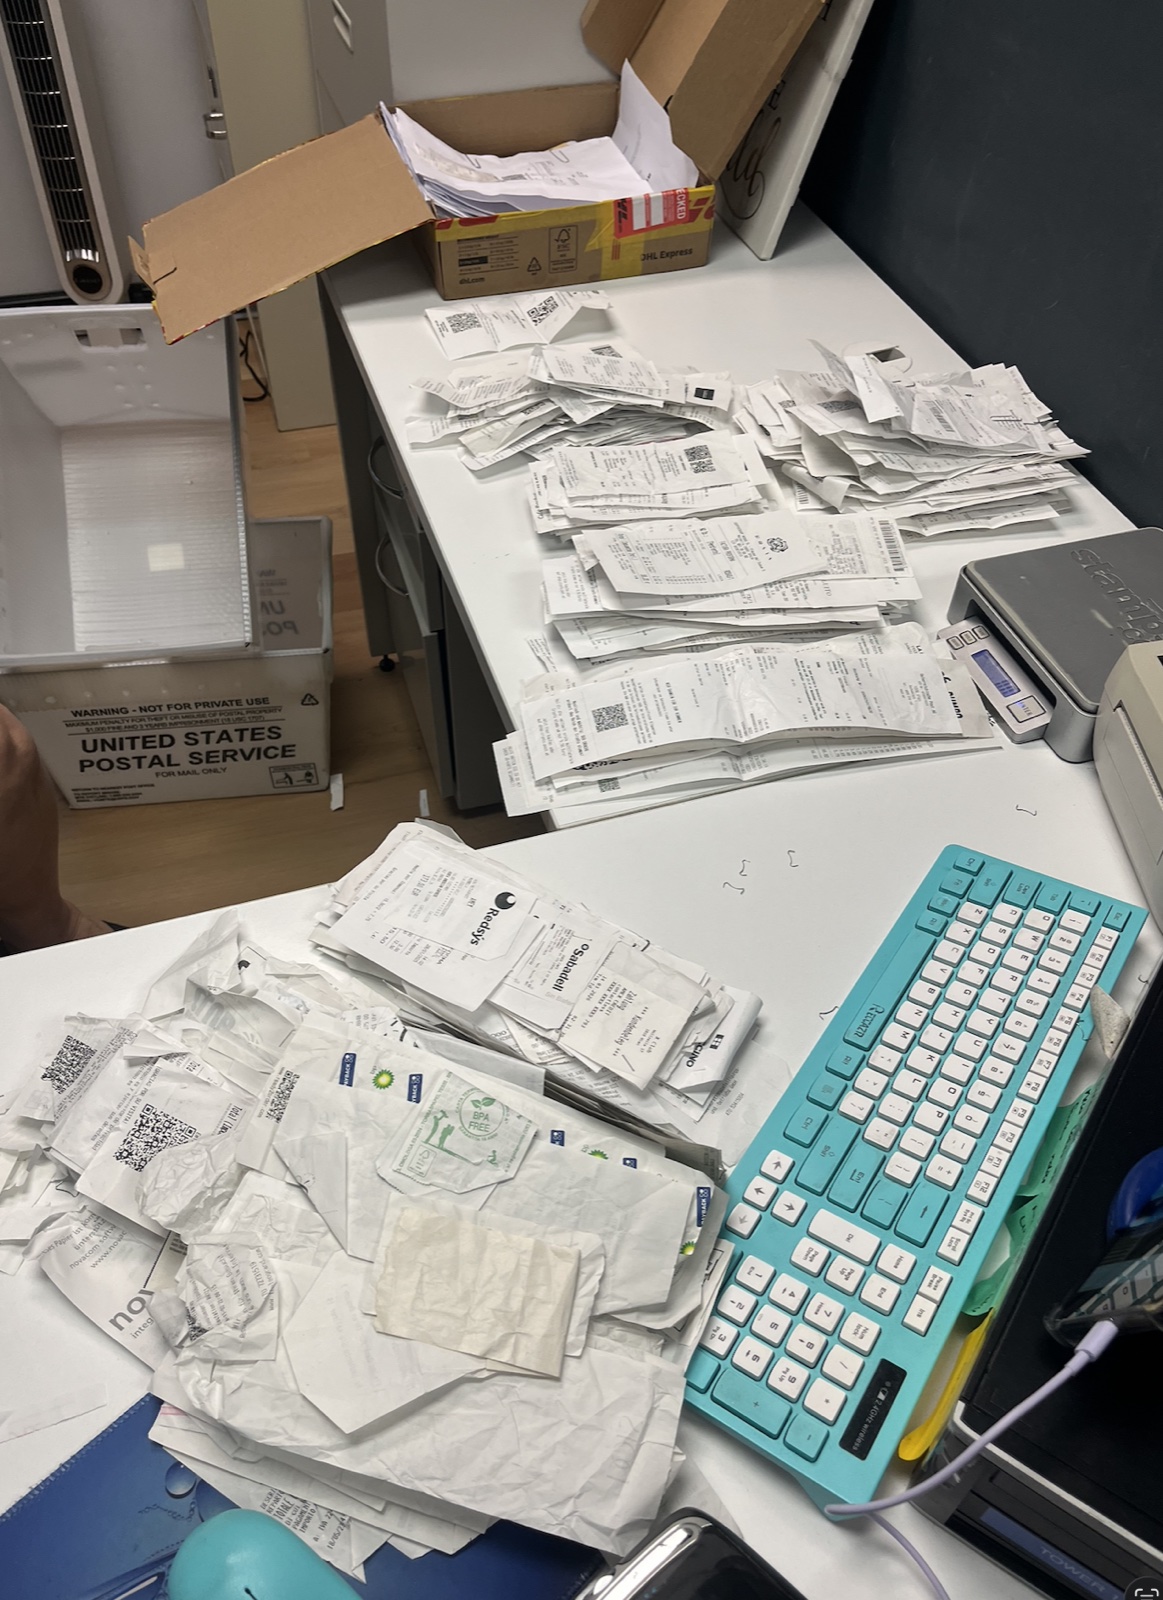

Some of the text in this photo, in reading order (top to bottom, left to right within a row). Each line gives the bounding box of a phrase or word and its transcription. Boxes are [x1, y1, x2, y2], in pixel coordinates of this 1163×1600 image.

[660, 247, 693, 260] Express
[70, 697, 270, 718] WARNING NOT FOR PRIVATE USE
[65, 720, 99, 728] MAXIMUM
[100, 718, 130, 726] PENALTY
[219, 709, 245, 717] POSTAL
[246, 707, 282, 715] PROPERTY
[81, 725, 282, 754] UNITED STATES
[78, 744, 297, 773] POSTAL SERVICE
[155, 766, 228, 778] FOR MAIL ONLY
[615, 988, 637, 1012] Zahlung
[613, 1012, 643, 1047] Kundenbeleg
[1031, 1081, 1041, 1092] F8
[225, 1103, 244, 1122] Total
[472, 1111, 491, 1122] BPA
[1017, 1107, 1028, 1118] F9
[468, 1121, 491, 1133] FREE
[1005, 1131, 1016, 1144] F10
[992, 1156, 1003, 1168] F11
[979, 1181, 991, 1193] F12
[51, 1232, 74, 1246] Papier
[67, 1242, 101, 1270] novacom
[893, 1255, 905, 1269] Home
[877, 1287, 887, 1299] End
[916, 1308, 926, 1318] Ins
[852, 1423, 869, 1451] wireless
[273, 1496, 295, 1522] TOTALE
[1040, 1545, 1106, 1592] TOWER
